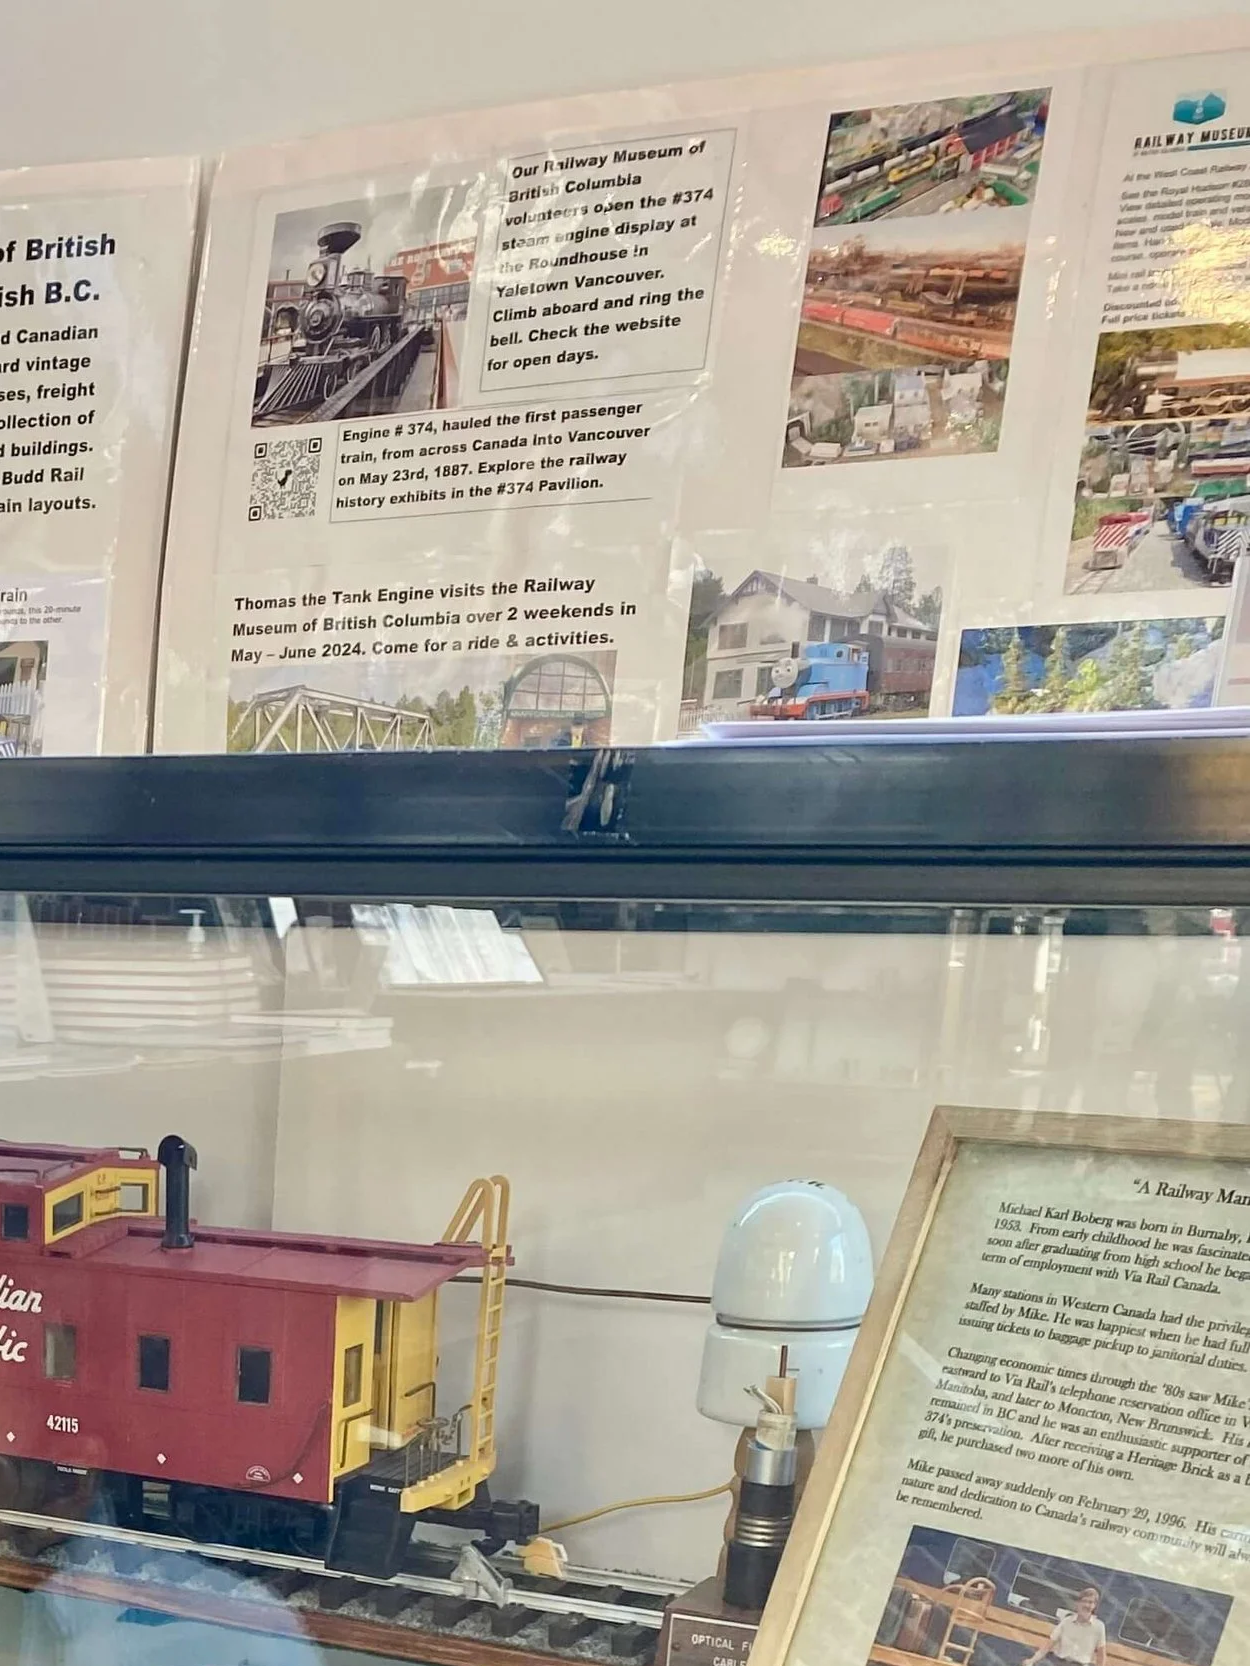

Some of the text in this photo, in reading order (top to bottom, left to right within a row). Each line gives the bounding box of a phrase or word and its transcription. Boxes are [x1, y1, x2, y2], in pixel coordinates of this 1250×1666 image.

[1134, 131, 1194, 149] RAILWAY
[25, 233, 115, 261] British
[44, 279, 99, 304] B.C.
[492, 287, 704, 322] Climb aboard and ring the
[16, 325, 98, 343] Canadian
[490, 315, 681, 347] bell. Check the website
[487, 350, 598, 371] for open days.
[36, 382, 94, 401] freight
[342, 428, 389, 442] Engine
[442, 415, 491, 431] hauled
[496, 414, 520, 426] the
[525, 409, 556, 423] first
[561, 403, 642, 423] passenger
[10, 440, 93, 456] buildings.
[234, 577, 595, 610] Thomas the Tank Engine visits the Railway
[1155, 1181, 1213, 1204] Railway
[999, 1201, 1241, 1244] Michael Karl Boberg was born in Burnaby,
[981, 1252, 1220, 1294] term of employment with Via Rail Canada.
[46, 1414, 79, 1434] 42115
[895, 1489, 982, 1519] be remembered.
[691, 1633, 735, 1651] OPTICAL
